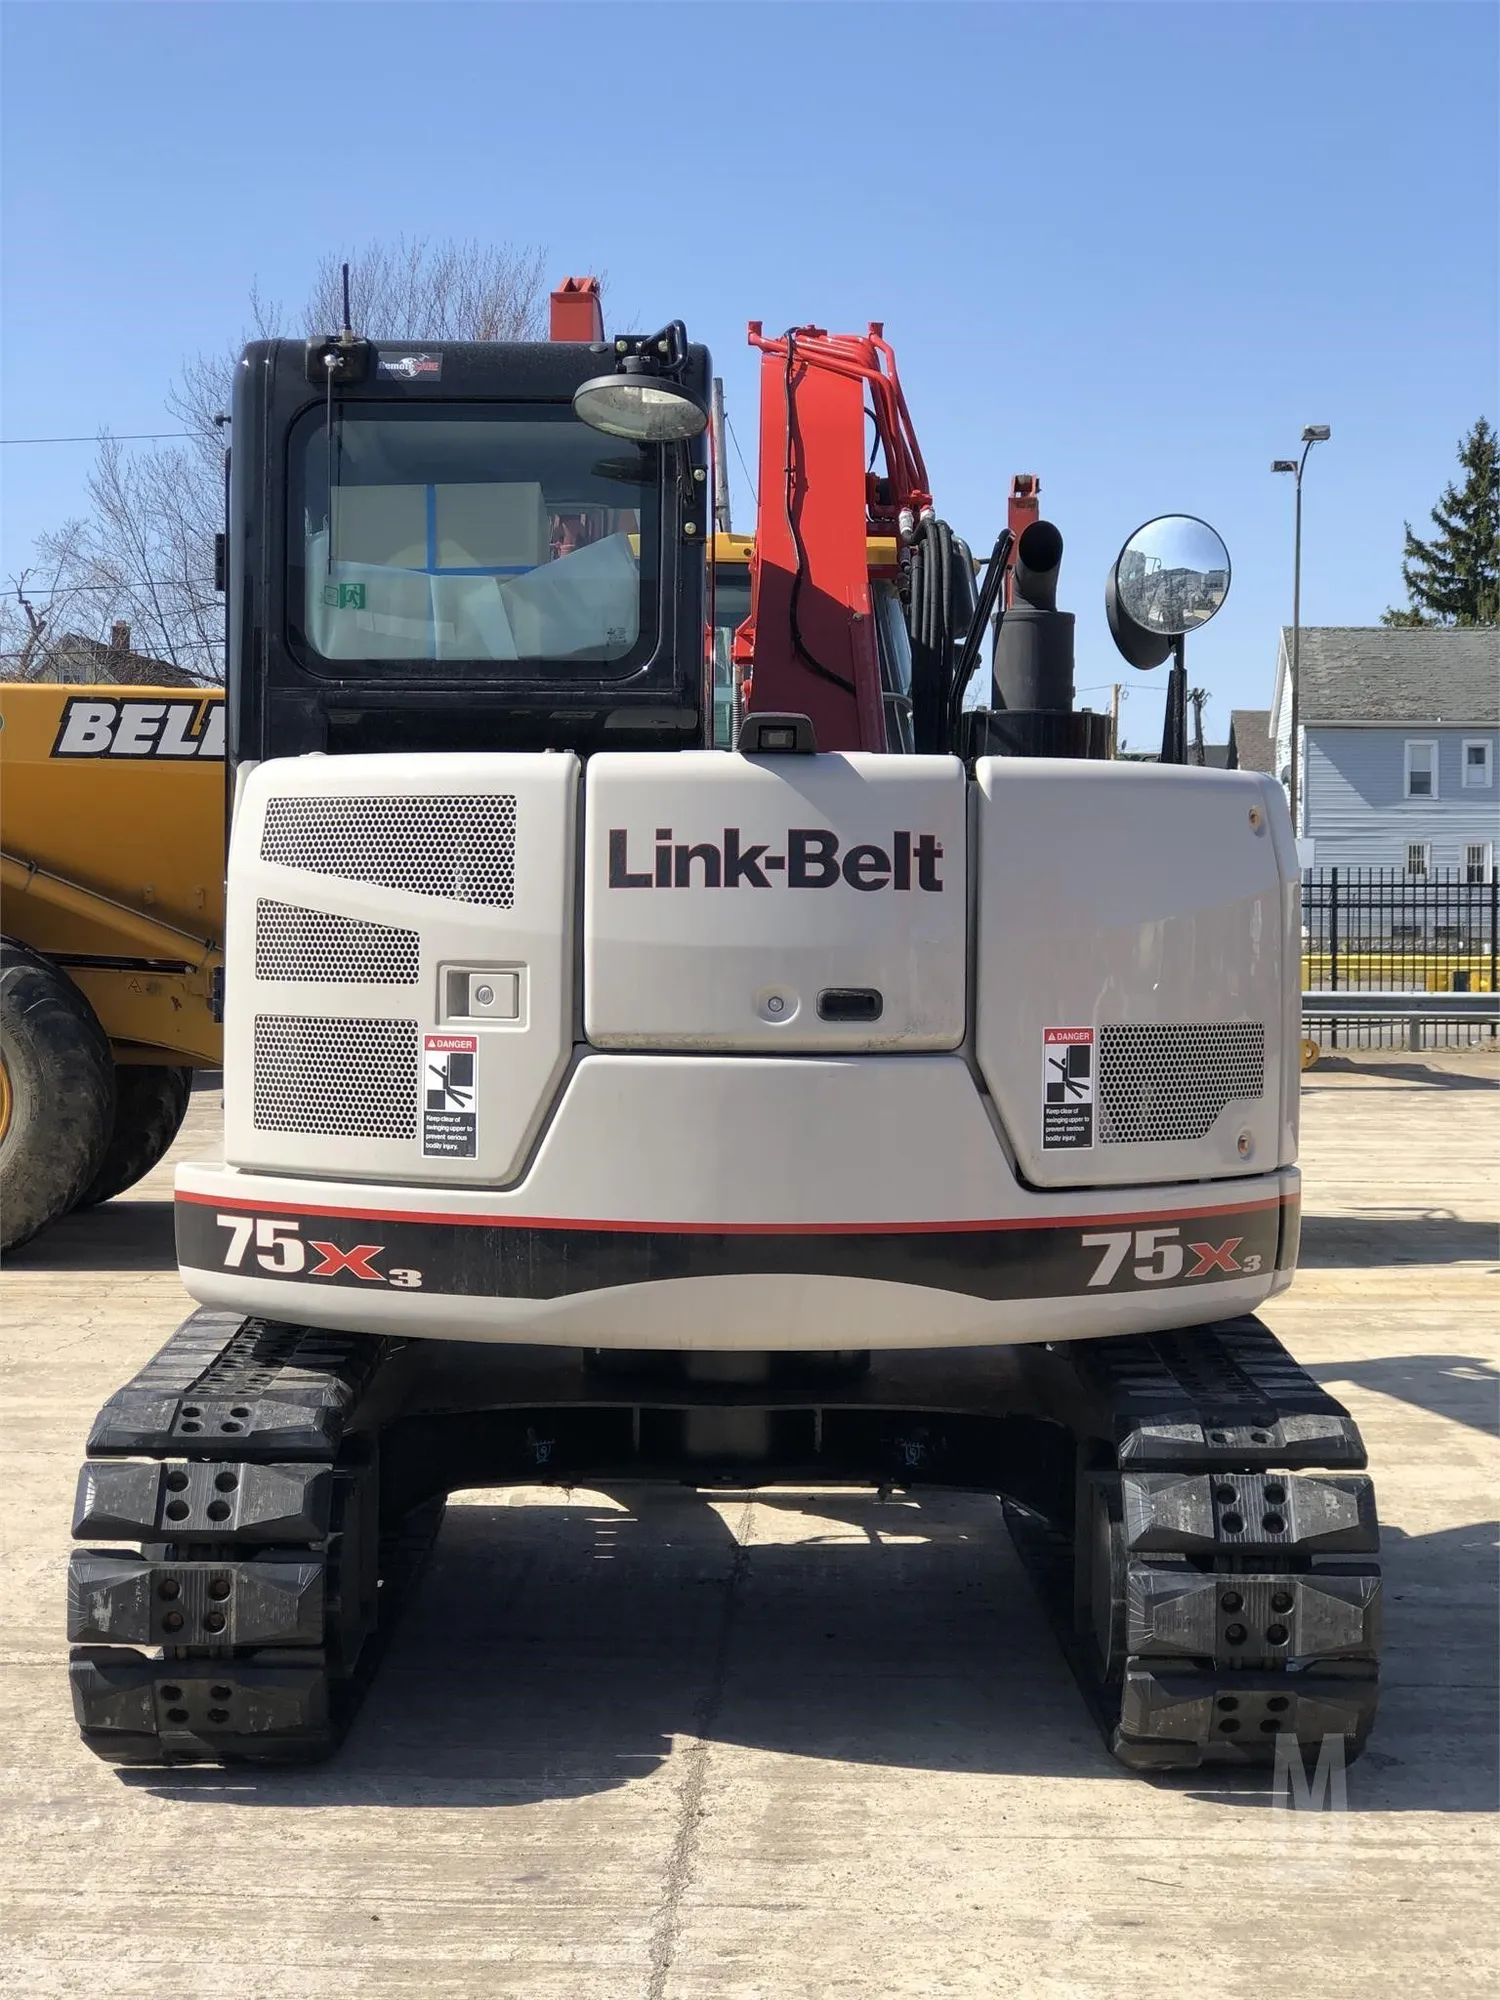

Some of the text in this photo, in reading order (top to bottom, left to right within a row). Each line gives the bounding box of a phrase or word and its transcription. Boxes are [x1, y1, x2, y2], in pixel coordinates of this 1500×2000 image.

[609, 828, 943, 892] Link-Belt
[1056, 1032, 1090, 1040] DANGER
[436, 1039, 473, 1049] DANGER
[426, 1114, 440, 1123] Keep
